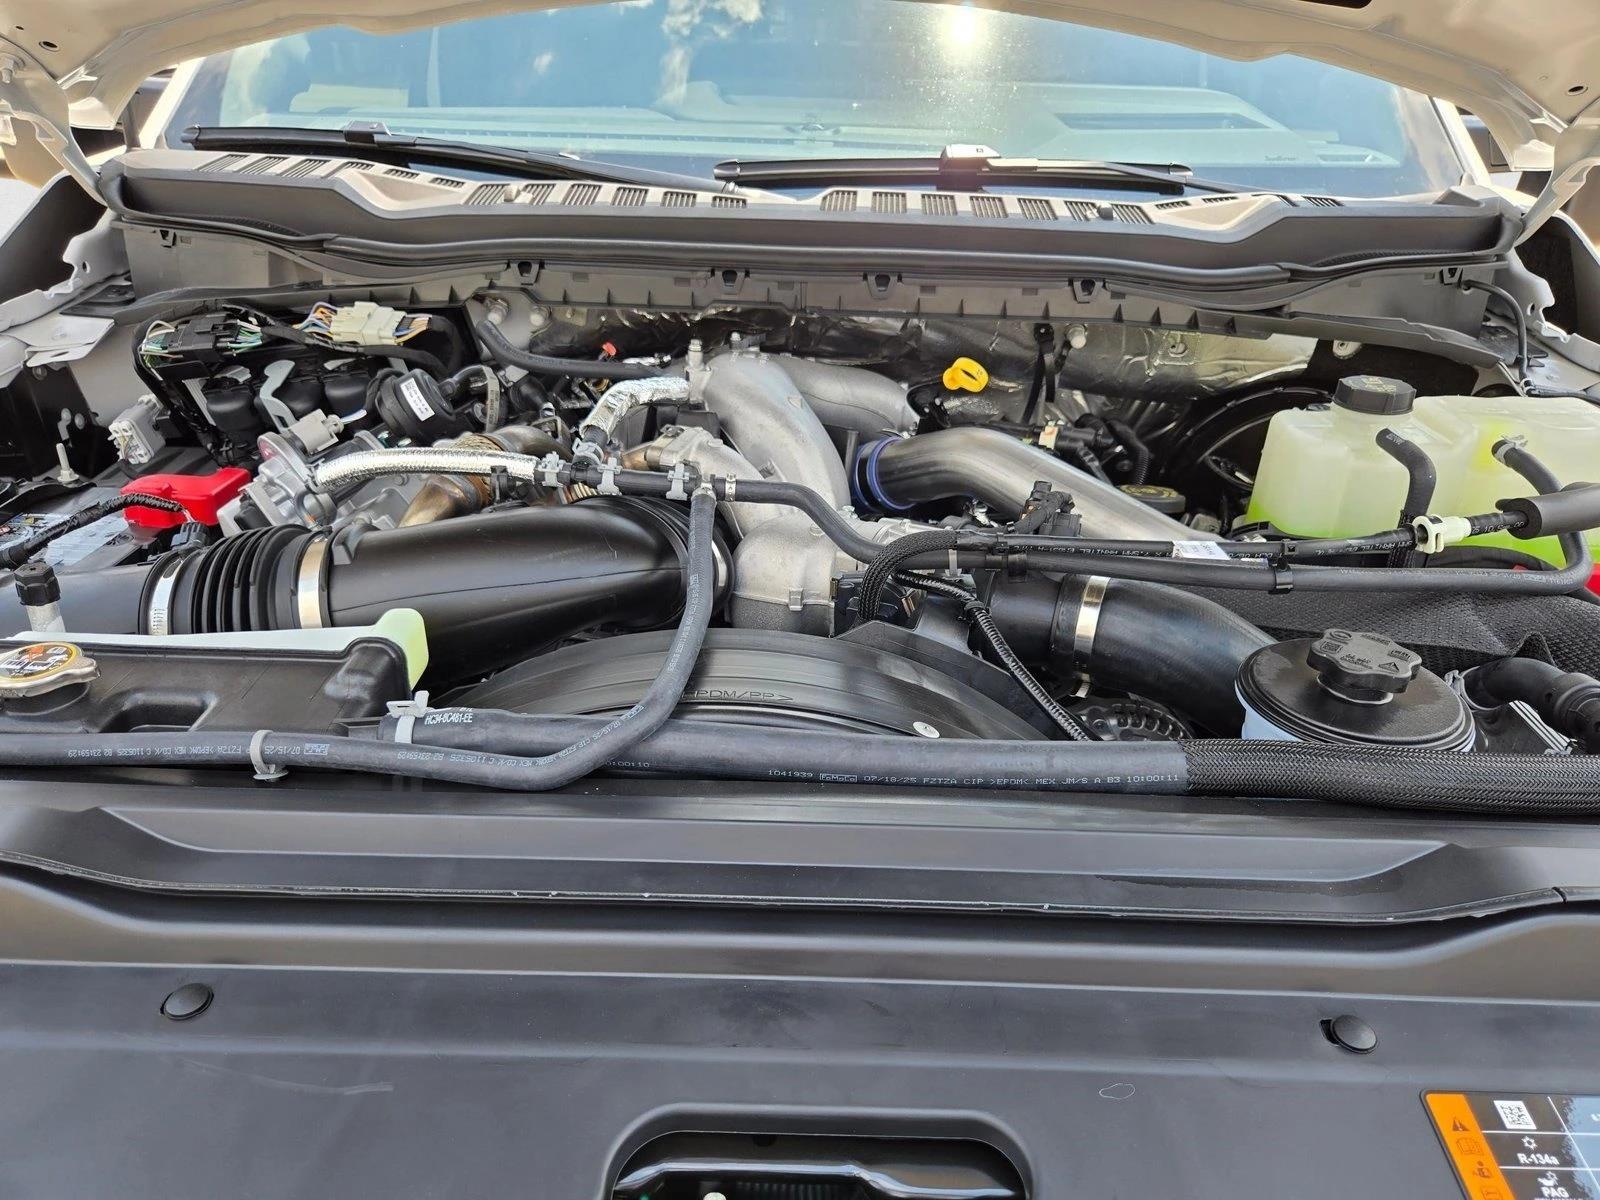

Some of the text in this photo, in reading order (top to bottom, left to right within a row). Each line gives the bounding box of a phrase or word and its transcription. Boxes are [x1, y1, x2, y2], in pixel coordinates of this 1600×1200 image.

[264, 745, 301, 755] 07/15/25
[768, 769, 813, 778] 1041939
[1127, 774, 1179, 782] 10:00:11
[1517, 1153, 1560, 1165] R-134a
[1541, 1187, 1570, 1198] PAG
